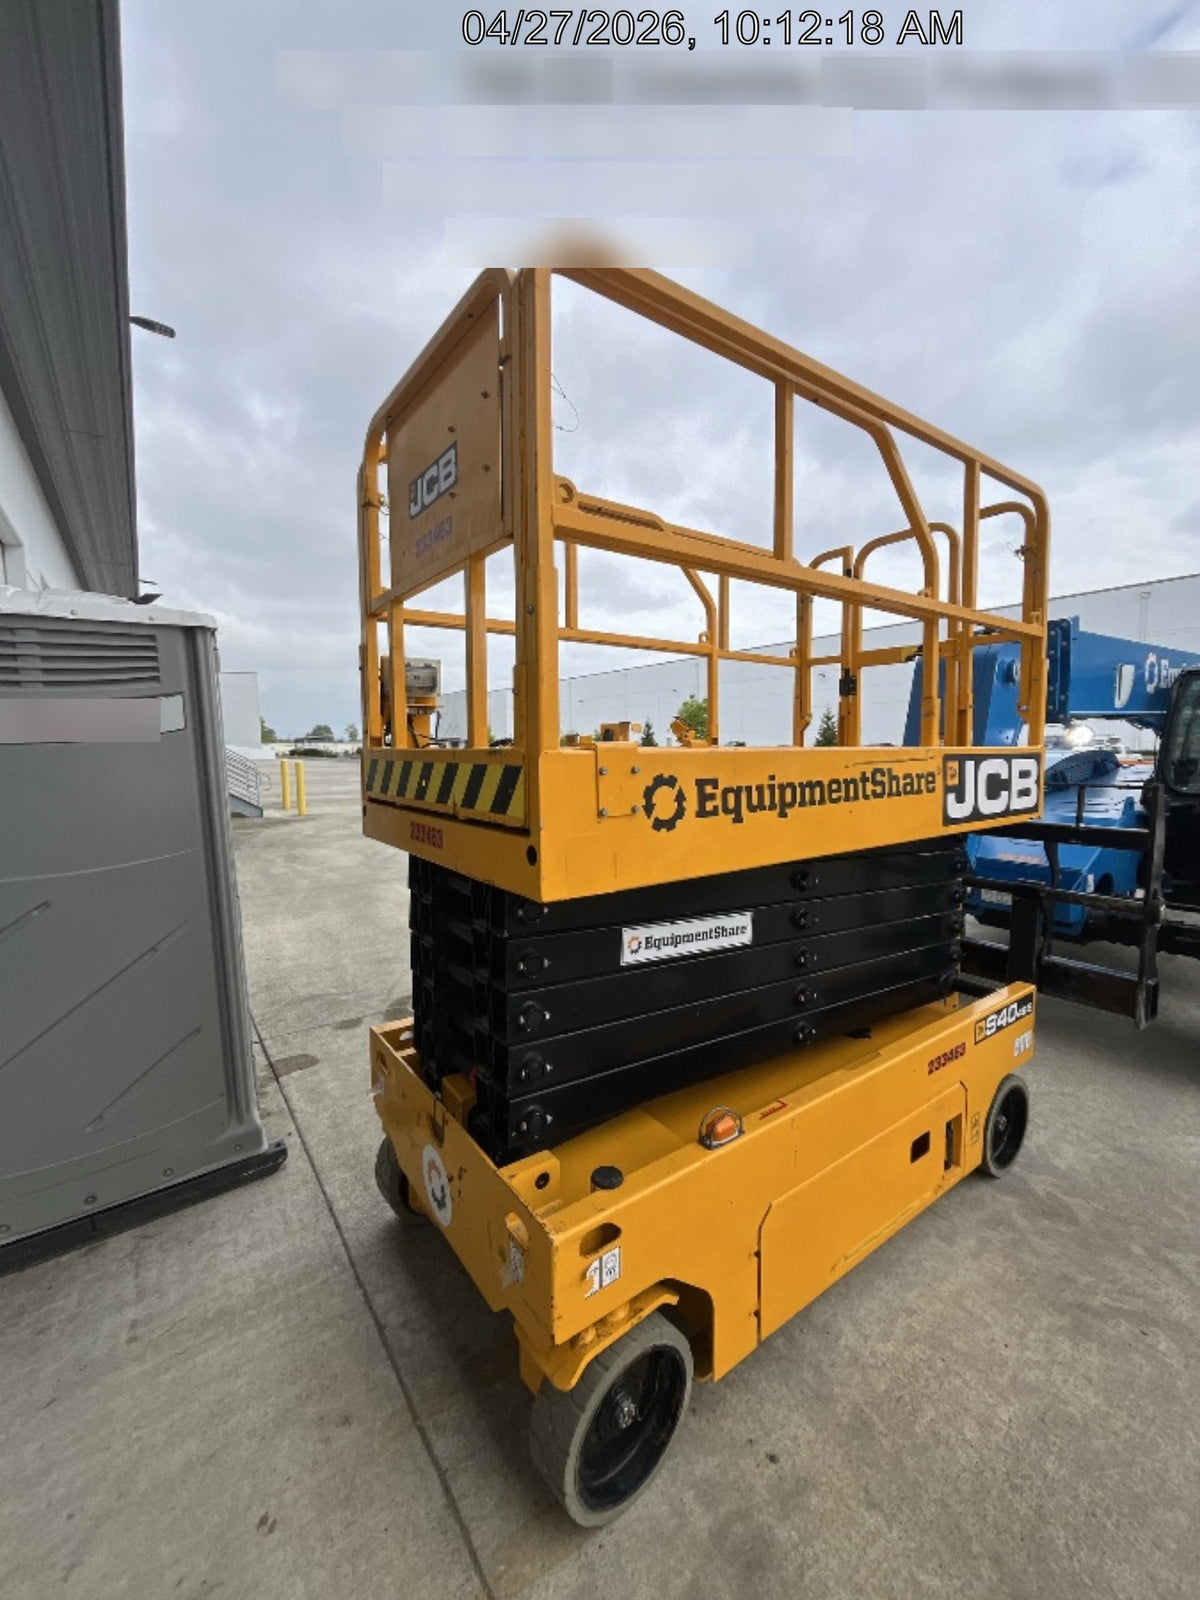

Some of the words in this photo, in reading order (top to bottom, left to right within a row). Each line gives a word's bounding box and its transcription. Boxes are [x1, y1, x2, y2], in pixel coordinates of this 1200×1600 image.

[410, 448, 456, 516] JCB
[695, 767, 936, 824] EquipmentShare
[946, 759, 1038, 818] JCB
[644, 925, 747, 949] EquipmentShare
[927, 1042, 966, 1076] 233463
